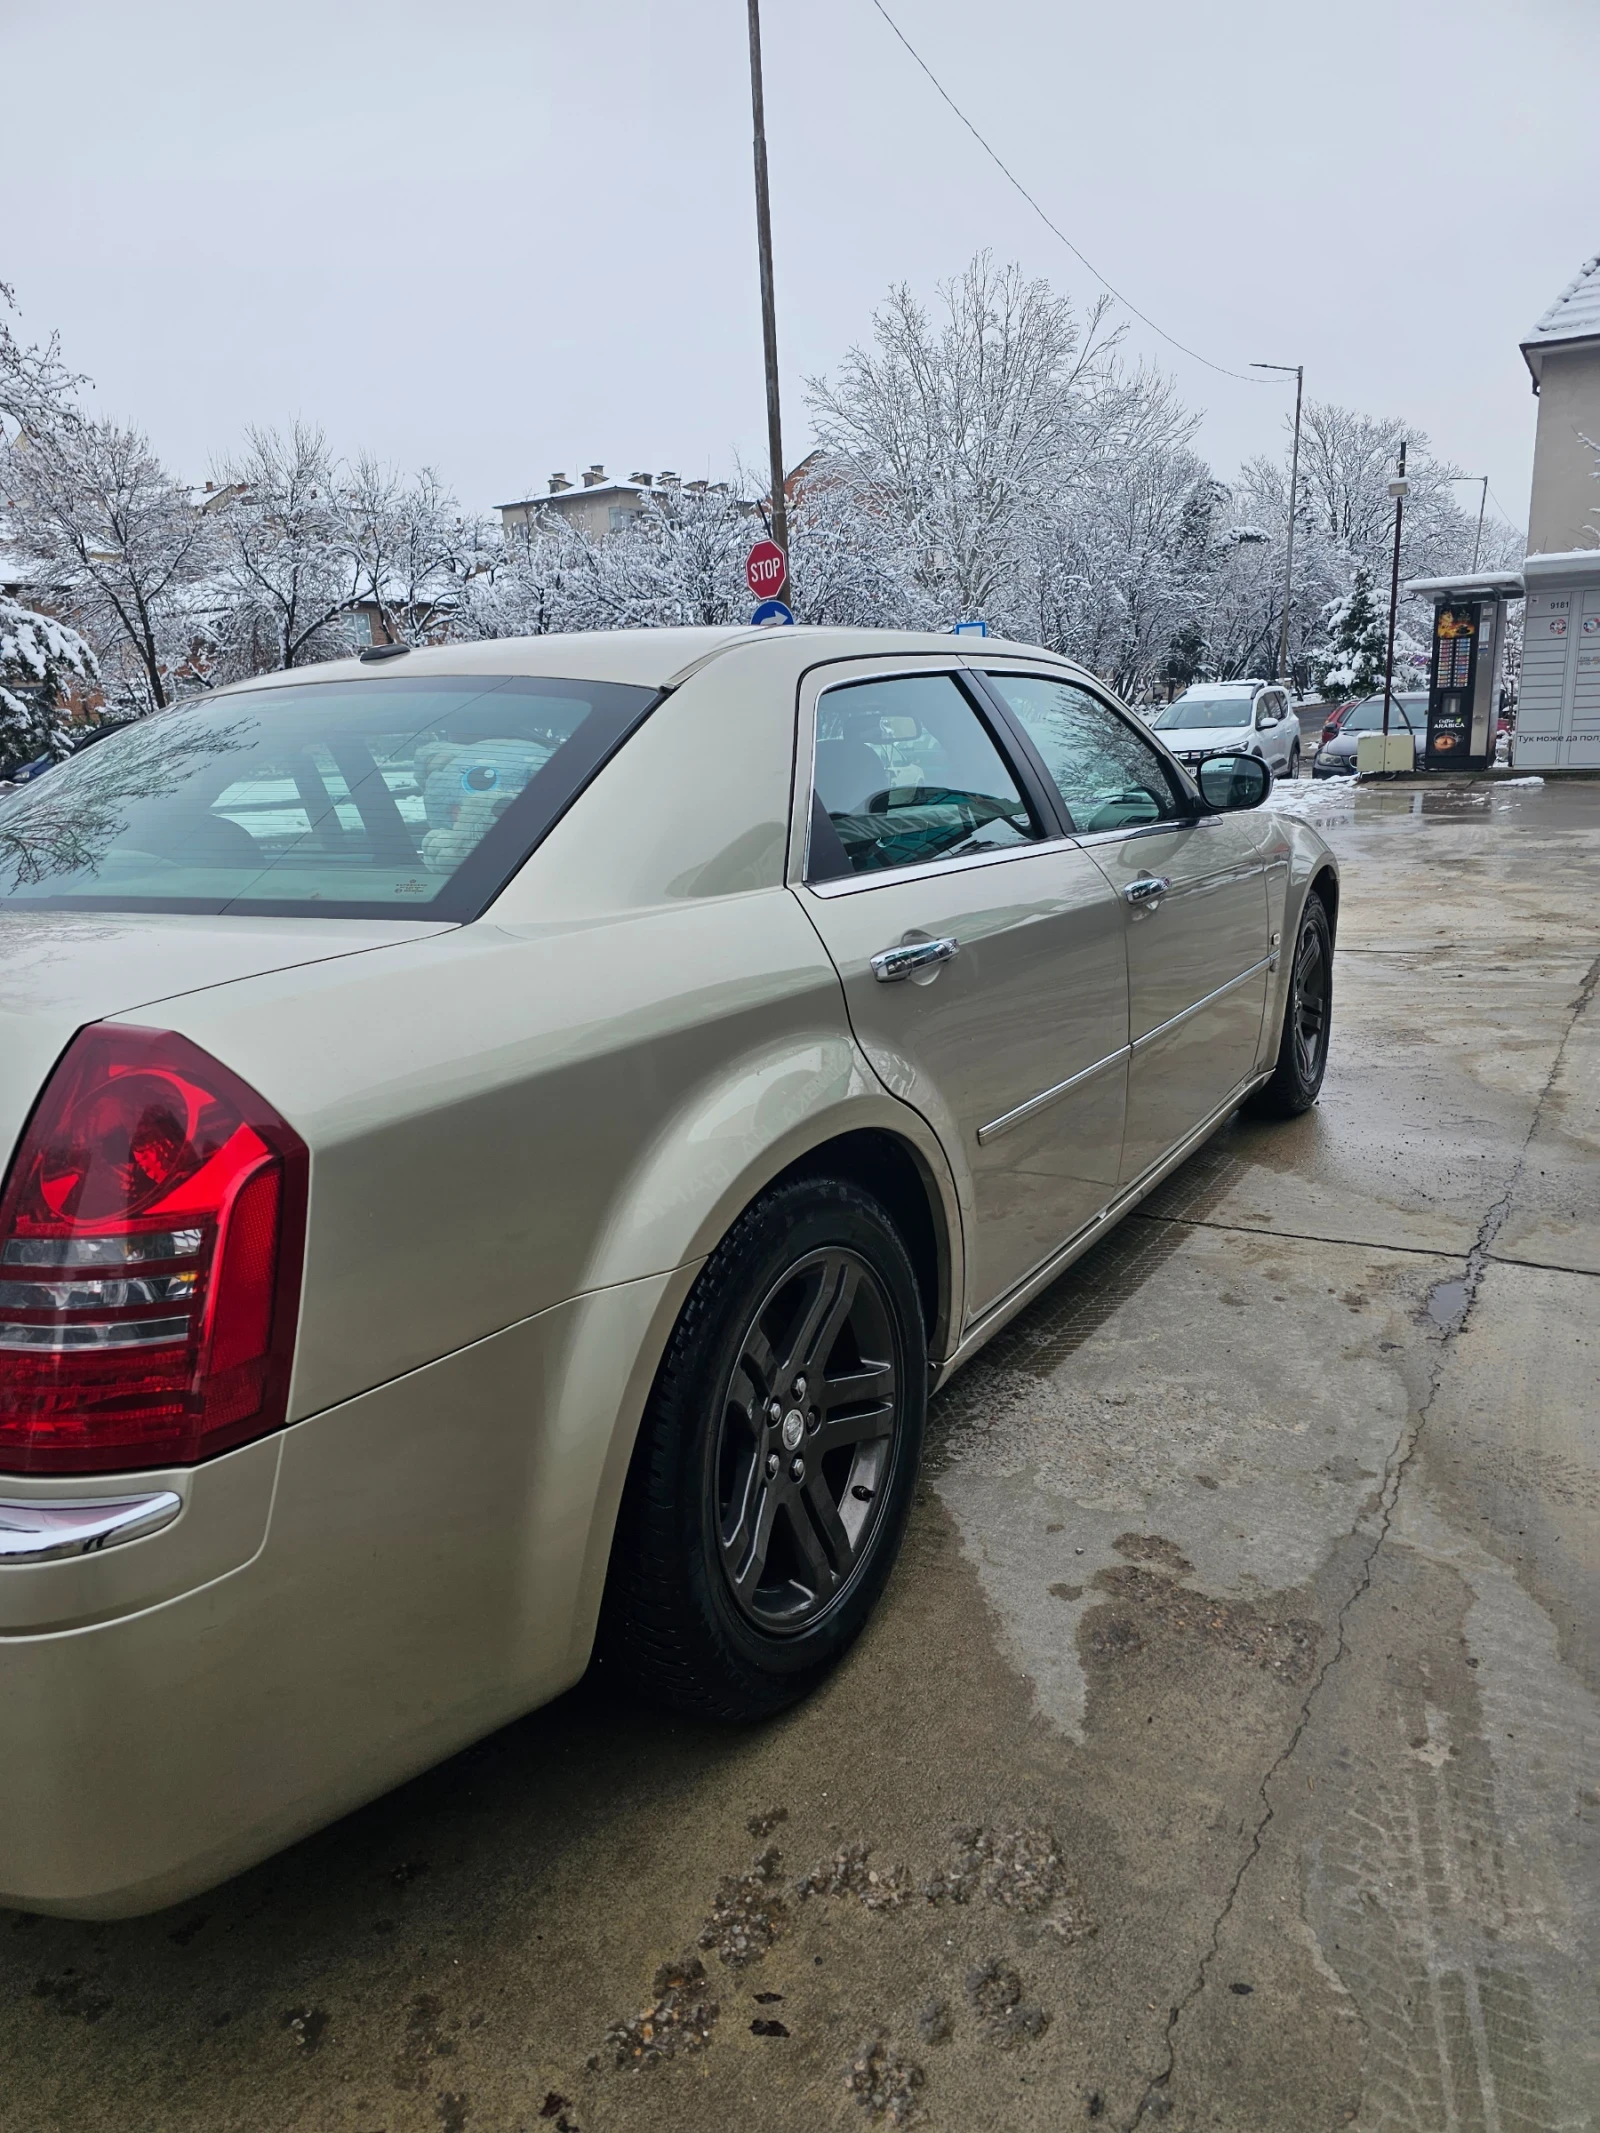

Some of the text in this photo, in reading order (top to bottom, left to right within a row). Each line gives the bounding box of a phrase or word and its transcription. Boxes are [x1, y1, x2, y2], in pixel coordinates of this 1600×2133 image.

[751, 557, 780, 582] STOP
[1550, 601, 1569, 609] 9181
[1518, 735, 1534, 744] Тук
[1566, 735, 1578, 743] да
[1580, 735, 1600, 743] пол
